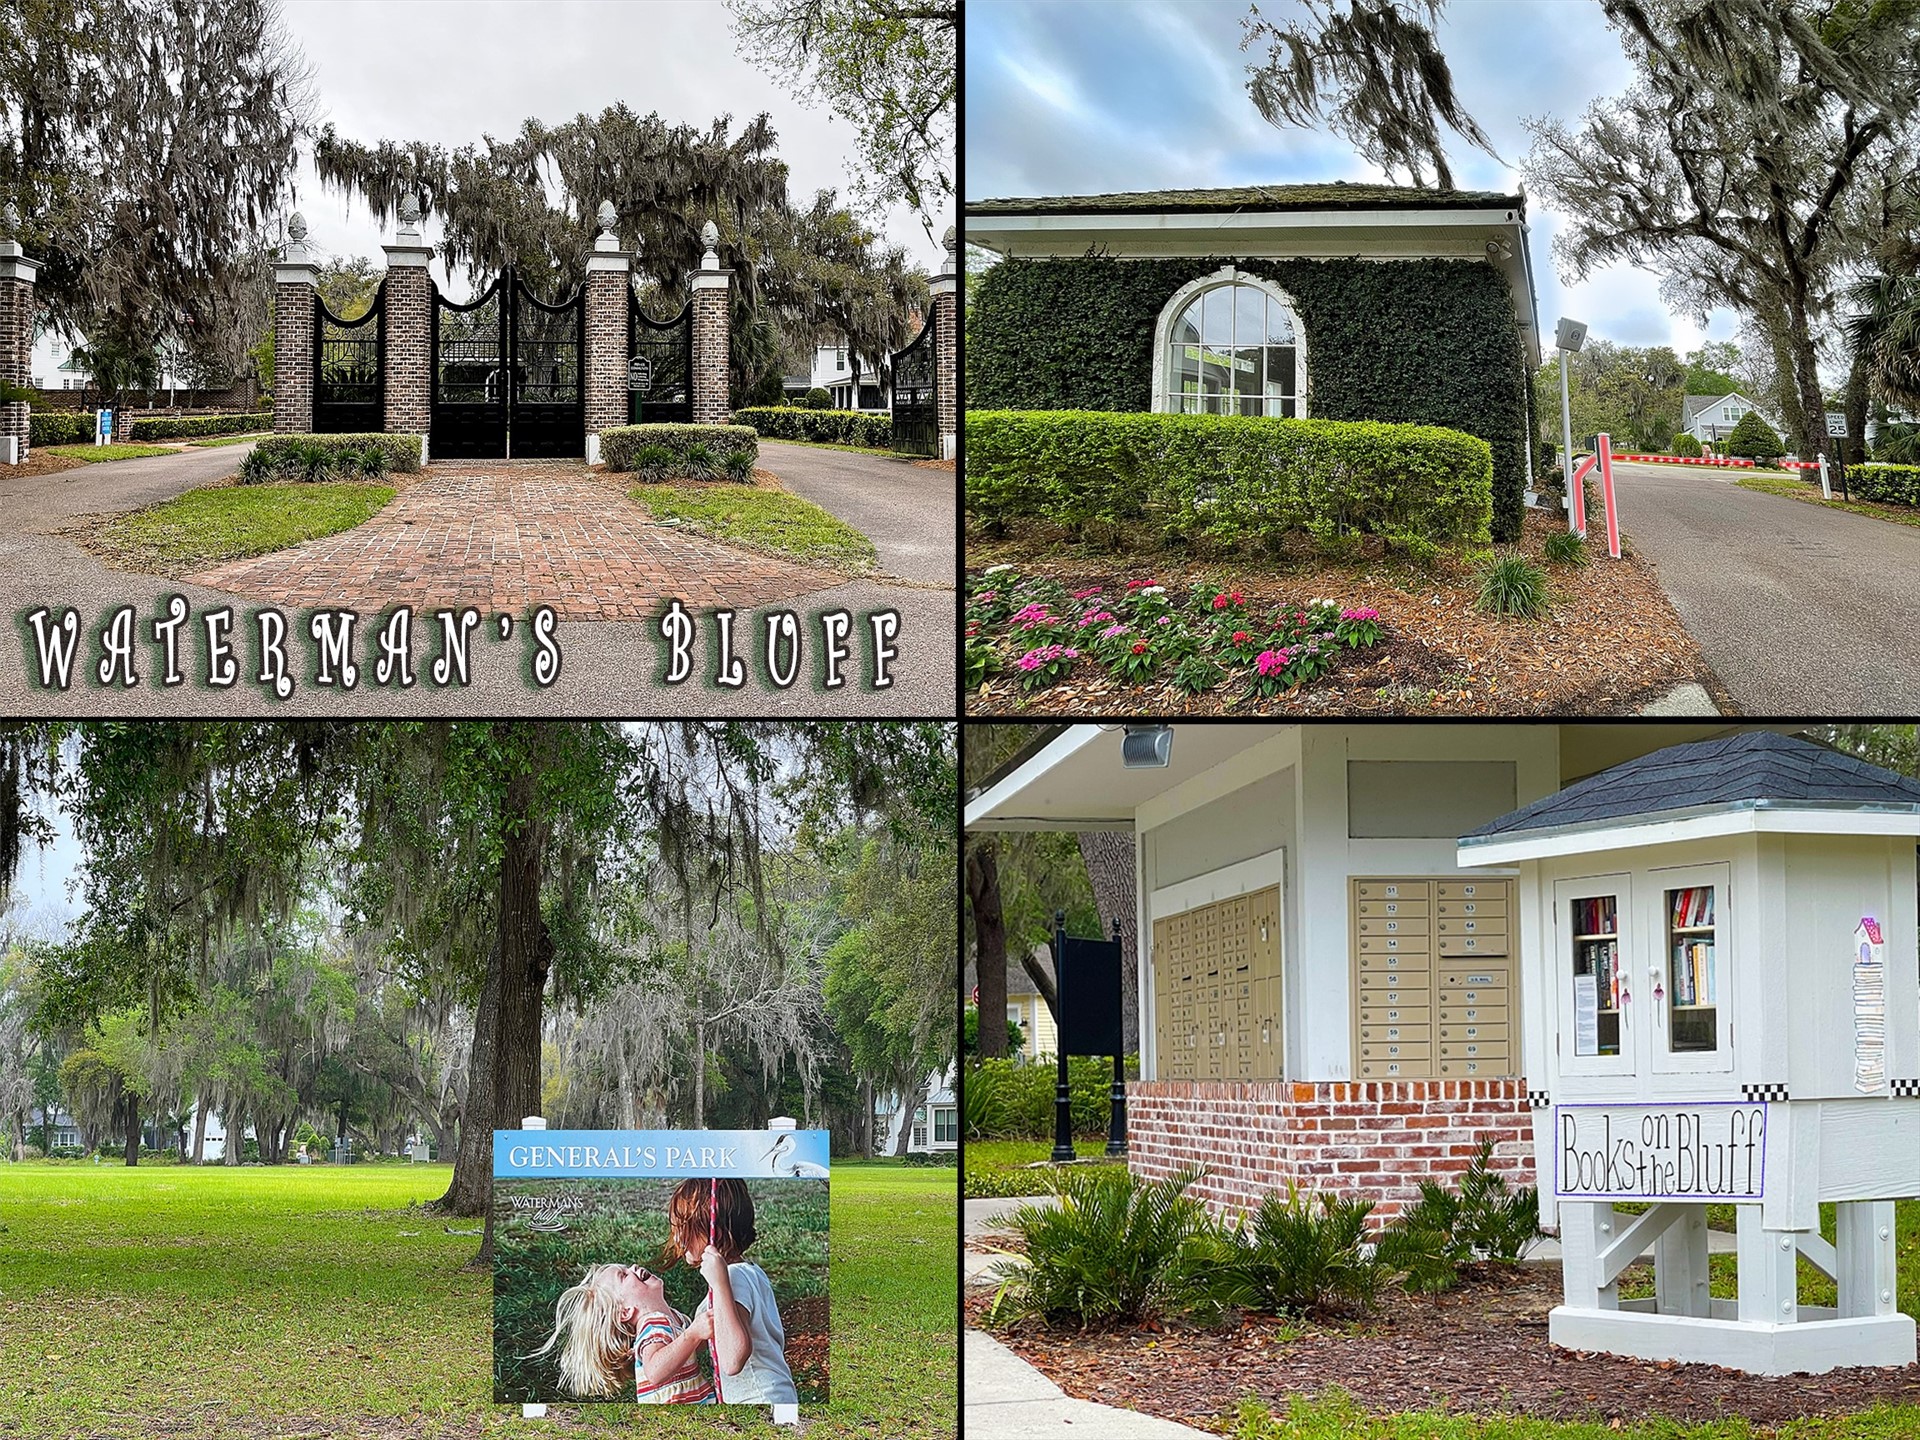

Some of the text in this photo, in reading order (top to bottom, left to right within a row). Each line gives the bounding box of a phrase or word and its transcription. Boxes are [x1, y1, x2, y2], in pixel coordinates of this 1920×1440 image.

[1830, 425, 1846, 435] 25
[508, 1145, 738, 1170] GENERAL'S PARK
[1561, 1110, 1764, 1196] Books on the Bluff
